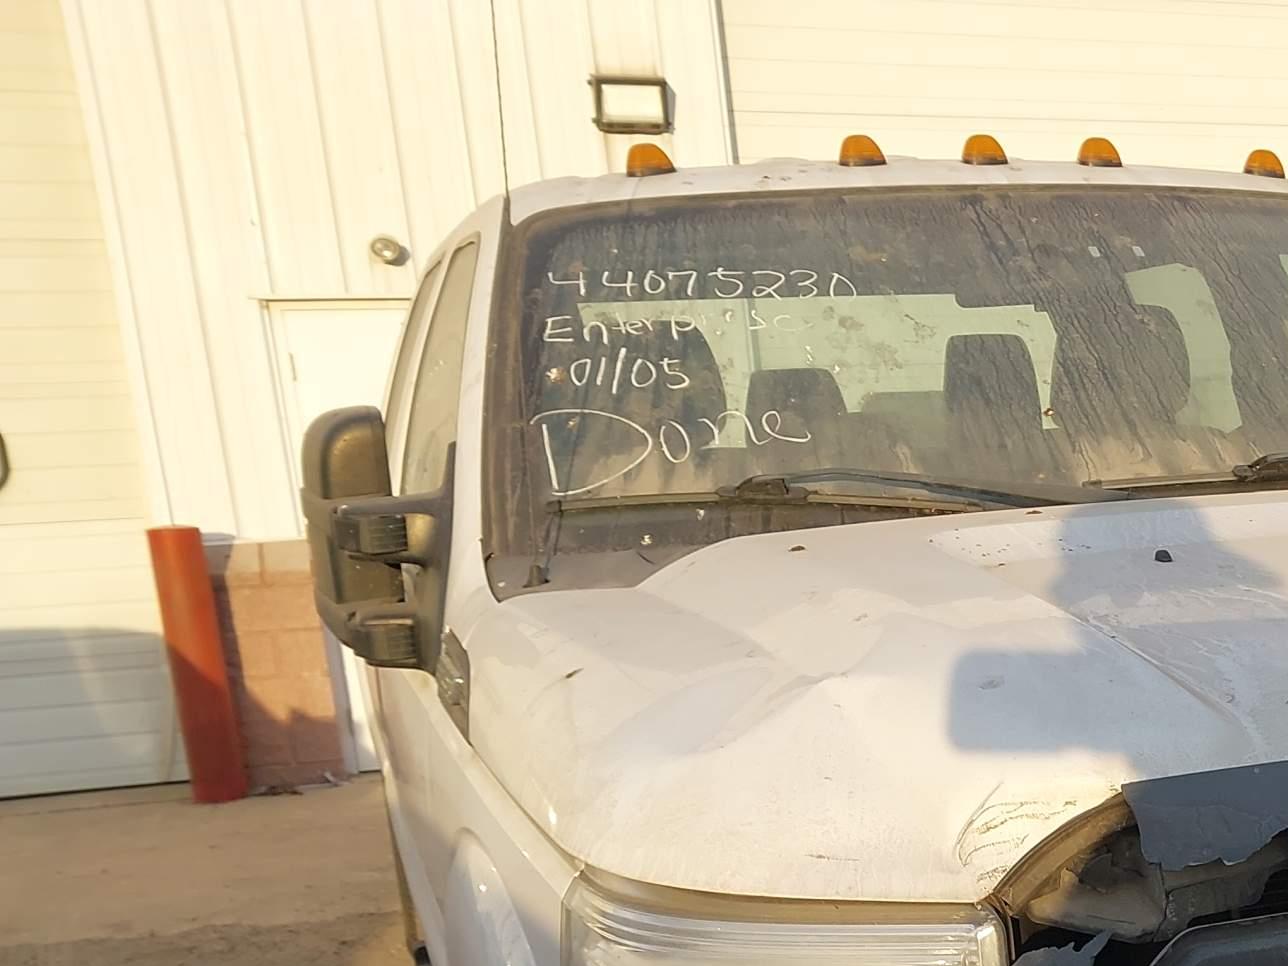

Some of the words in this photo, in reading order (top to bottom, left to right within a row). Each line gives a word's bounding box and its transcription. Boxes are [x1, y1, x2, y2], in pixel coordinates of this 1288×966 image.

[548, 267, 857, 300] 44075230
[569, 347, 691, 395] 01/05
[530, 408, 812, 497] Done
